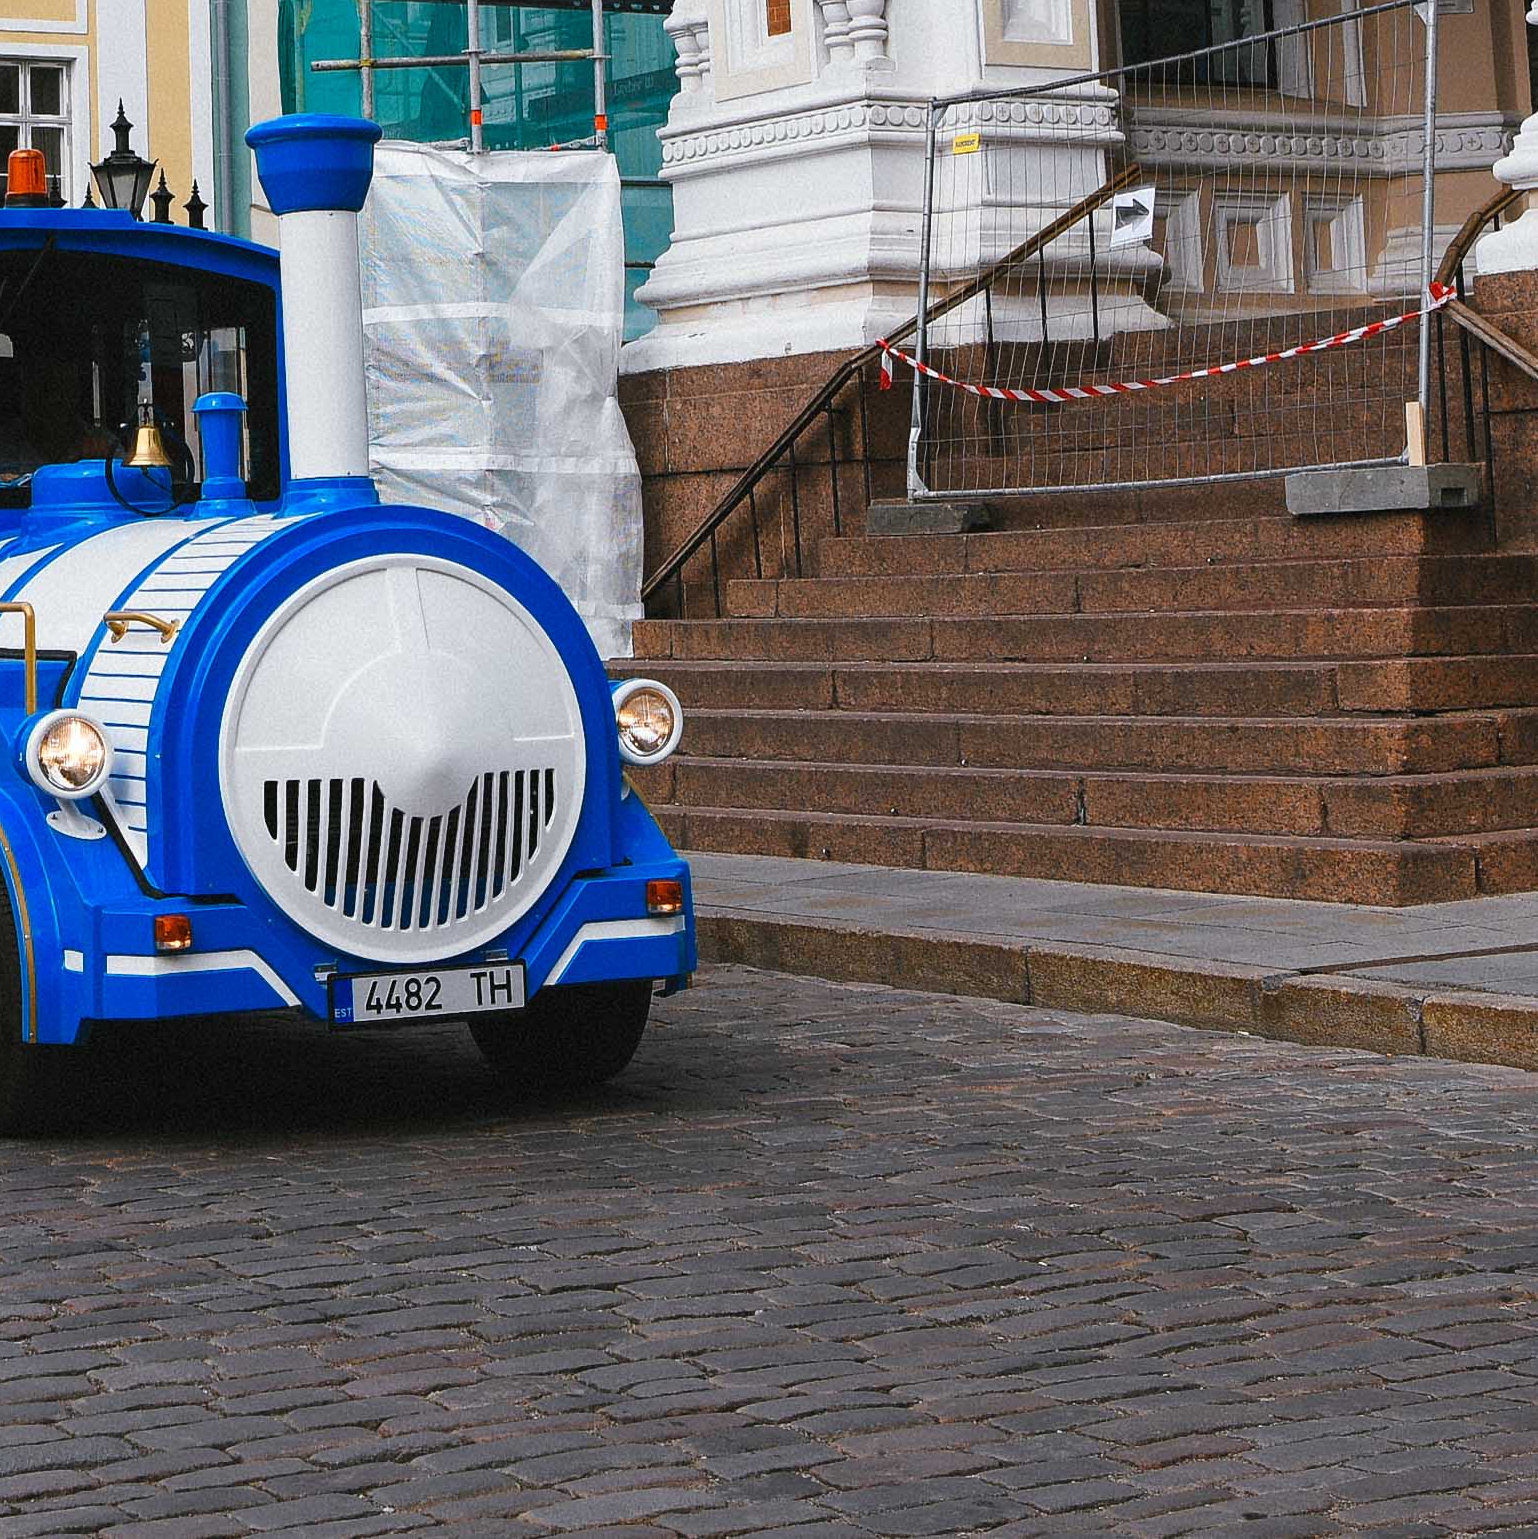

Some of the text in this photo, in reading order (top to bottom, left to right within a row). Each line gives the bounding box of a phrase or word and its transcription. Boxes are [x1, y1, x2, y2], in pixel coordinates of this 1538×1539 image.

[365, 970, 513, 1015] 4482 TH
[334, 1007, 353, 1020] EST
